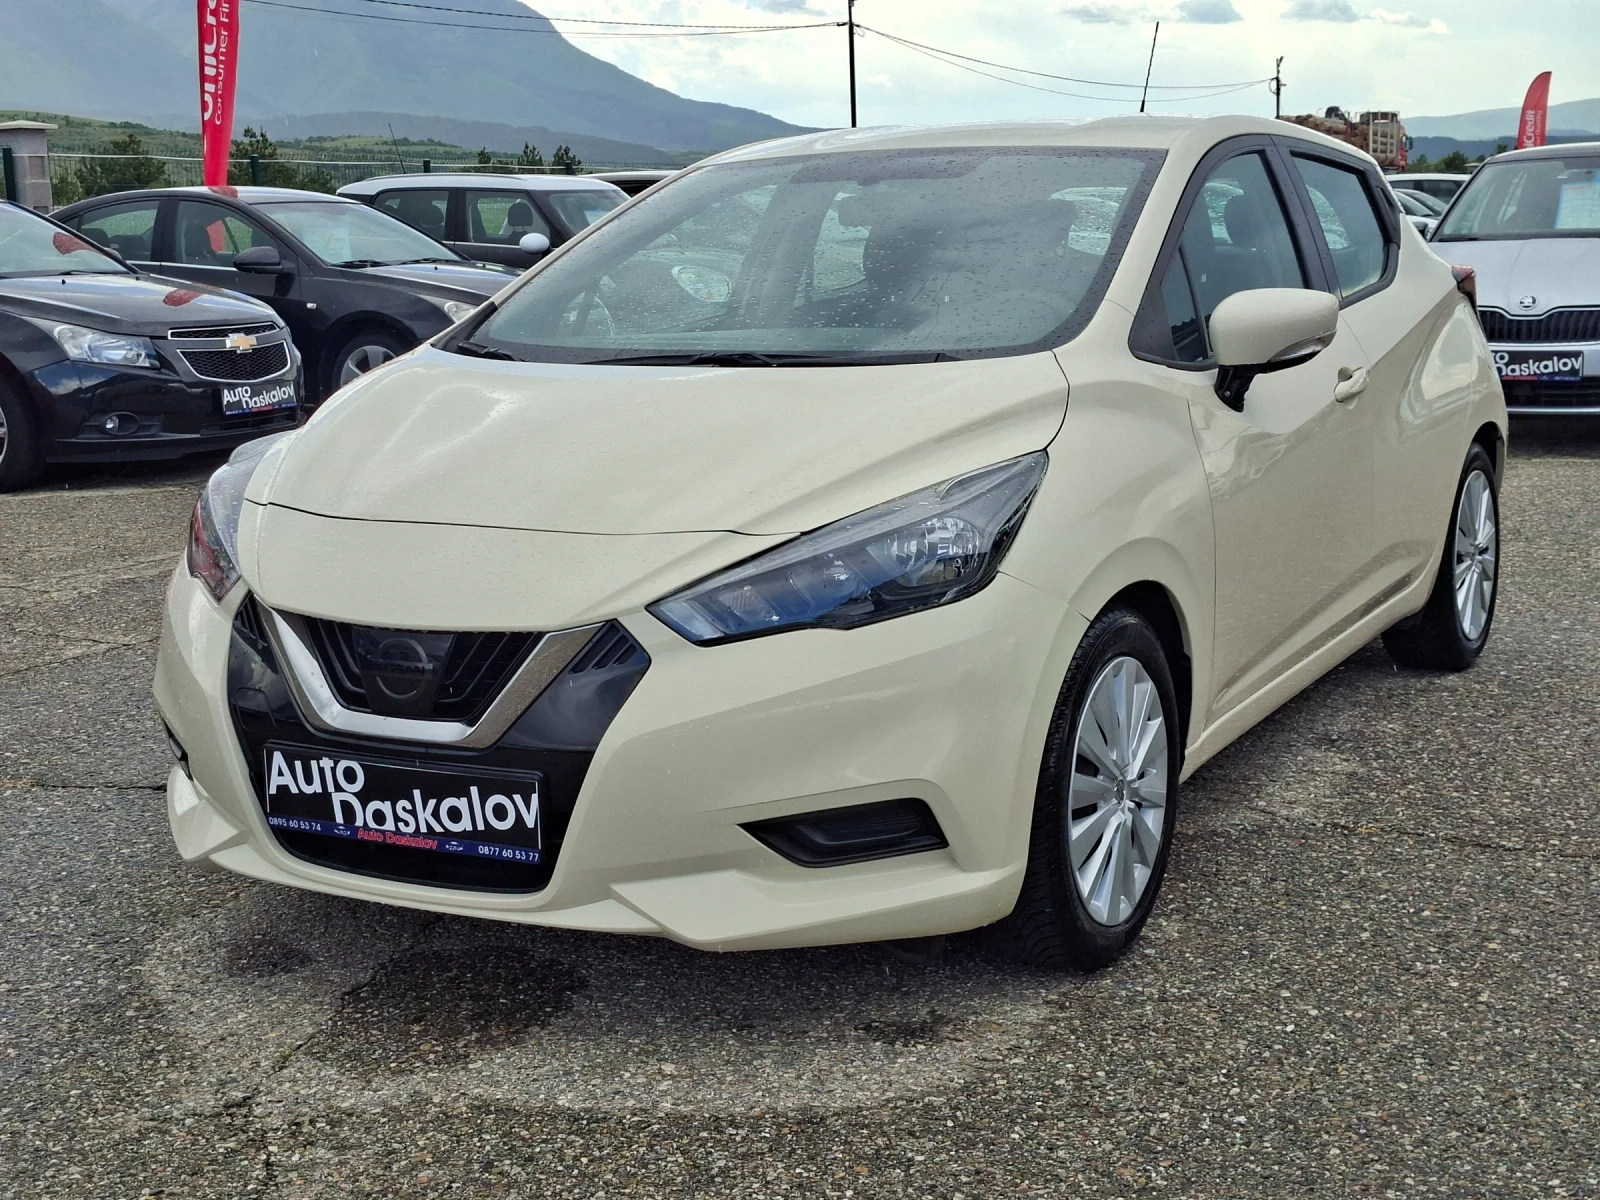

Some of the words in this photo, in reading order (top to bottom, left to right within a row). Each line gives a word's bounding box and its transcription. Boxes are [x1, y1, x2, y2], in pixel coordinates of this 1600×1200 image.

[223, 386, 251, 404] Auto
[269, 751, 365, 795] Auto
[331, 785, 538, 833] Daskalov
[268, 817, 287, 826] 0895
[289, 819, 299, 828] 60
[300, 821, 309, 830] 53
[311, 822, 321, 831] 74
[358, 828, 384, 841] Auto
[385, 832, 438, 849] Daskalov
[478, 845, 500, 856] 0877
[502, 849, 513, 858] 60
[515, 850, 526, 860] 53
[528, 852, 539, 862] 77
